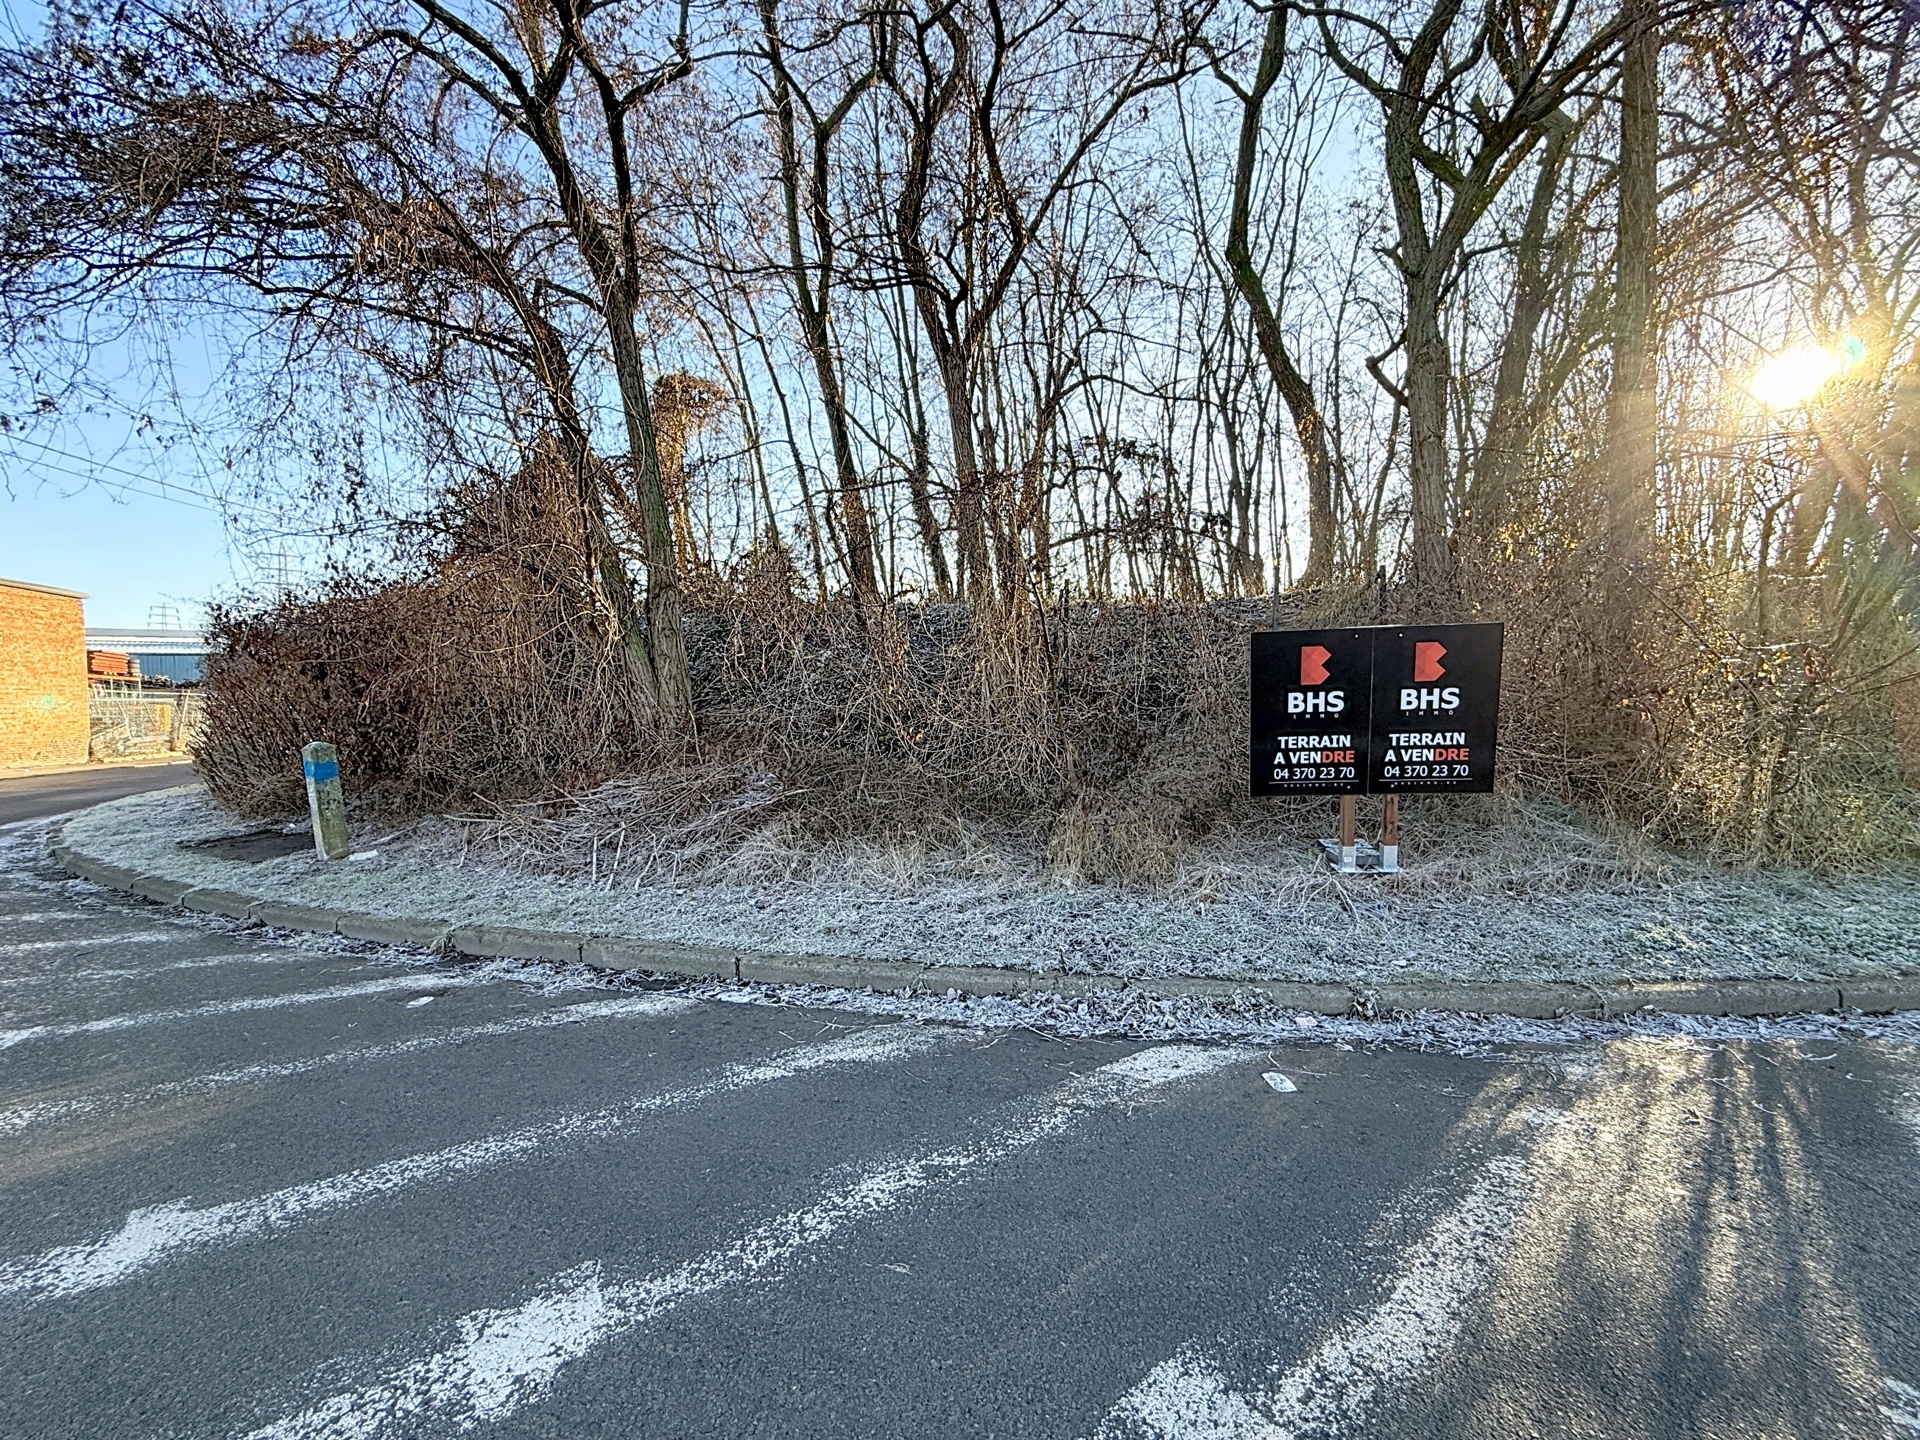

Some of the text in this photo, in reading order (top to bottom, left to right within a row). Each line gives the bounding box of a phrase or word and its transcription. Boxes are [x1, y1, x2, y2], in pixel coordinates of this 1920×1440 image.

[1287, 691, 1345, 713] BHS
[1400, 688, 1460, 710] BHS
[1277, 735, 1351, 749] TERRAIN
[1389, 732, 1466, 746] TERRAIN
[1273, 750, 1355, 764] A VENDRE
[1384, 748, 1470, 762] A VENDRE
[1273, 766, 1355, 780] 04 370 23 70
[1384, 764, 1469, 778] 04 370 23 70
